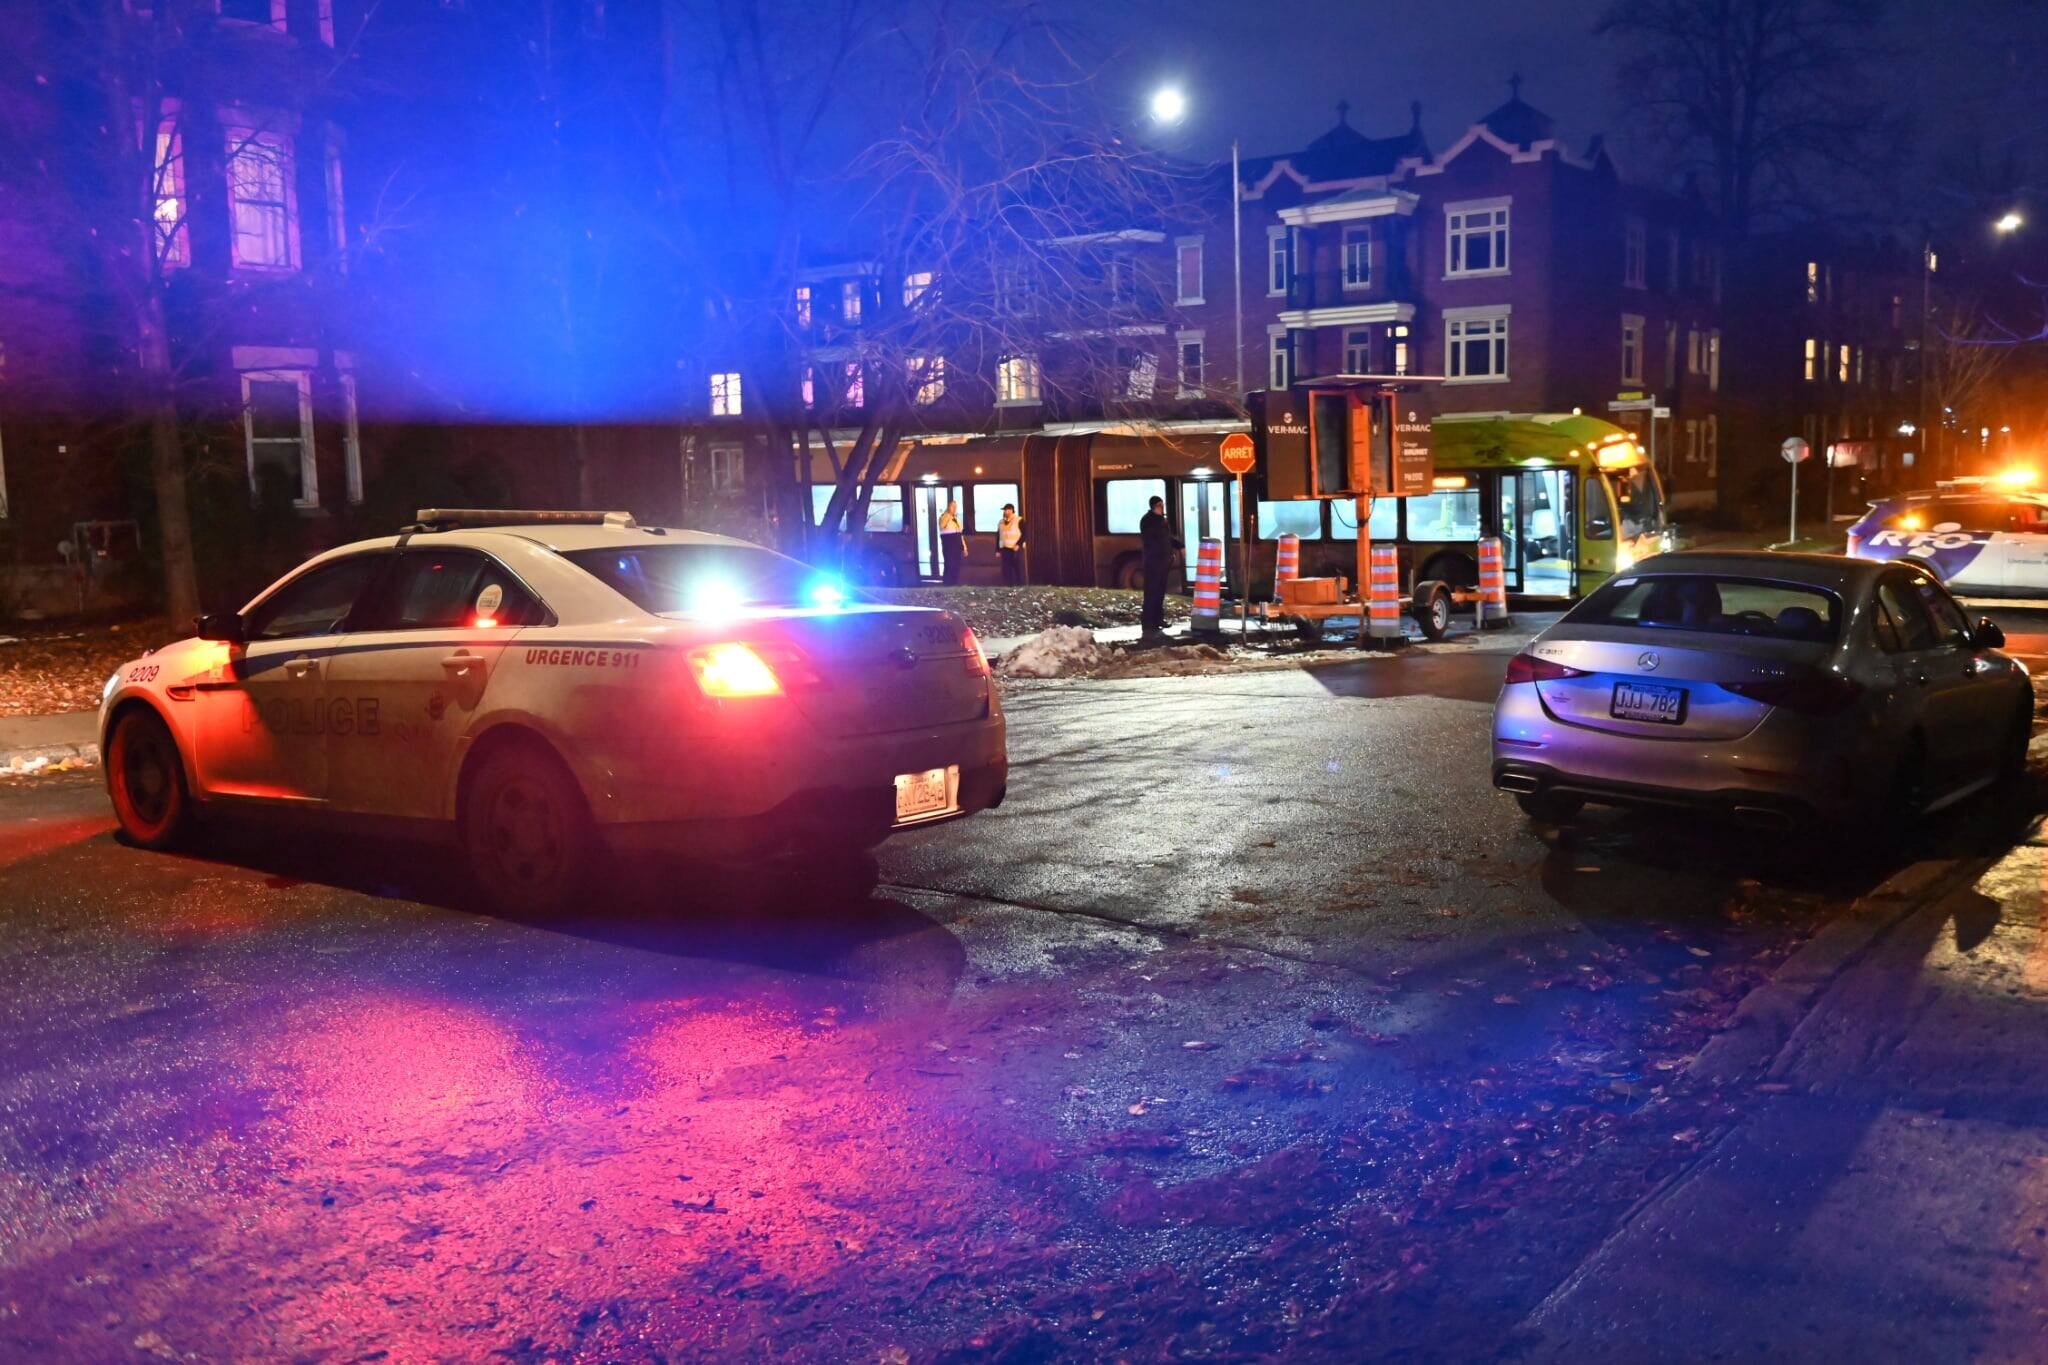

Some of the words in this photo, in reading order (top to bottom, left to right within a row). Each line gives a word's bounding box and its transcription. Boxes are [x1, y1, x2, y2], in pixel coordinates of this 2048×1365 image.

[1267, 425, 1308, 434] VER-MAC
[1394, 424, 1431, 433] VER-MAC
[1223, 446, 1253, 459] ARRÊT
[525, 649, 609, 667] URGENCE
[611, 652, 640, 668] 911
[126, 664, 160, 683] 9209
[1615, 690, 1643, 709] JJJ
[1649, 694, 1677, 713] 782
[242, 697, 381, 736] POLICE
